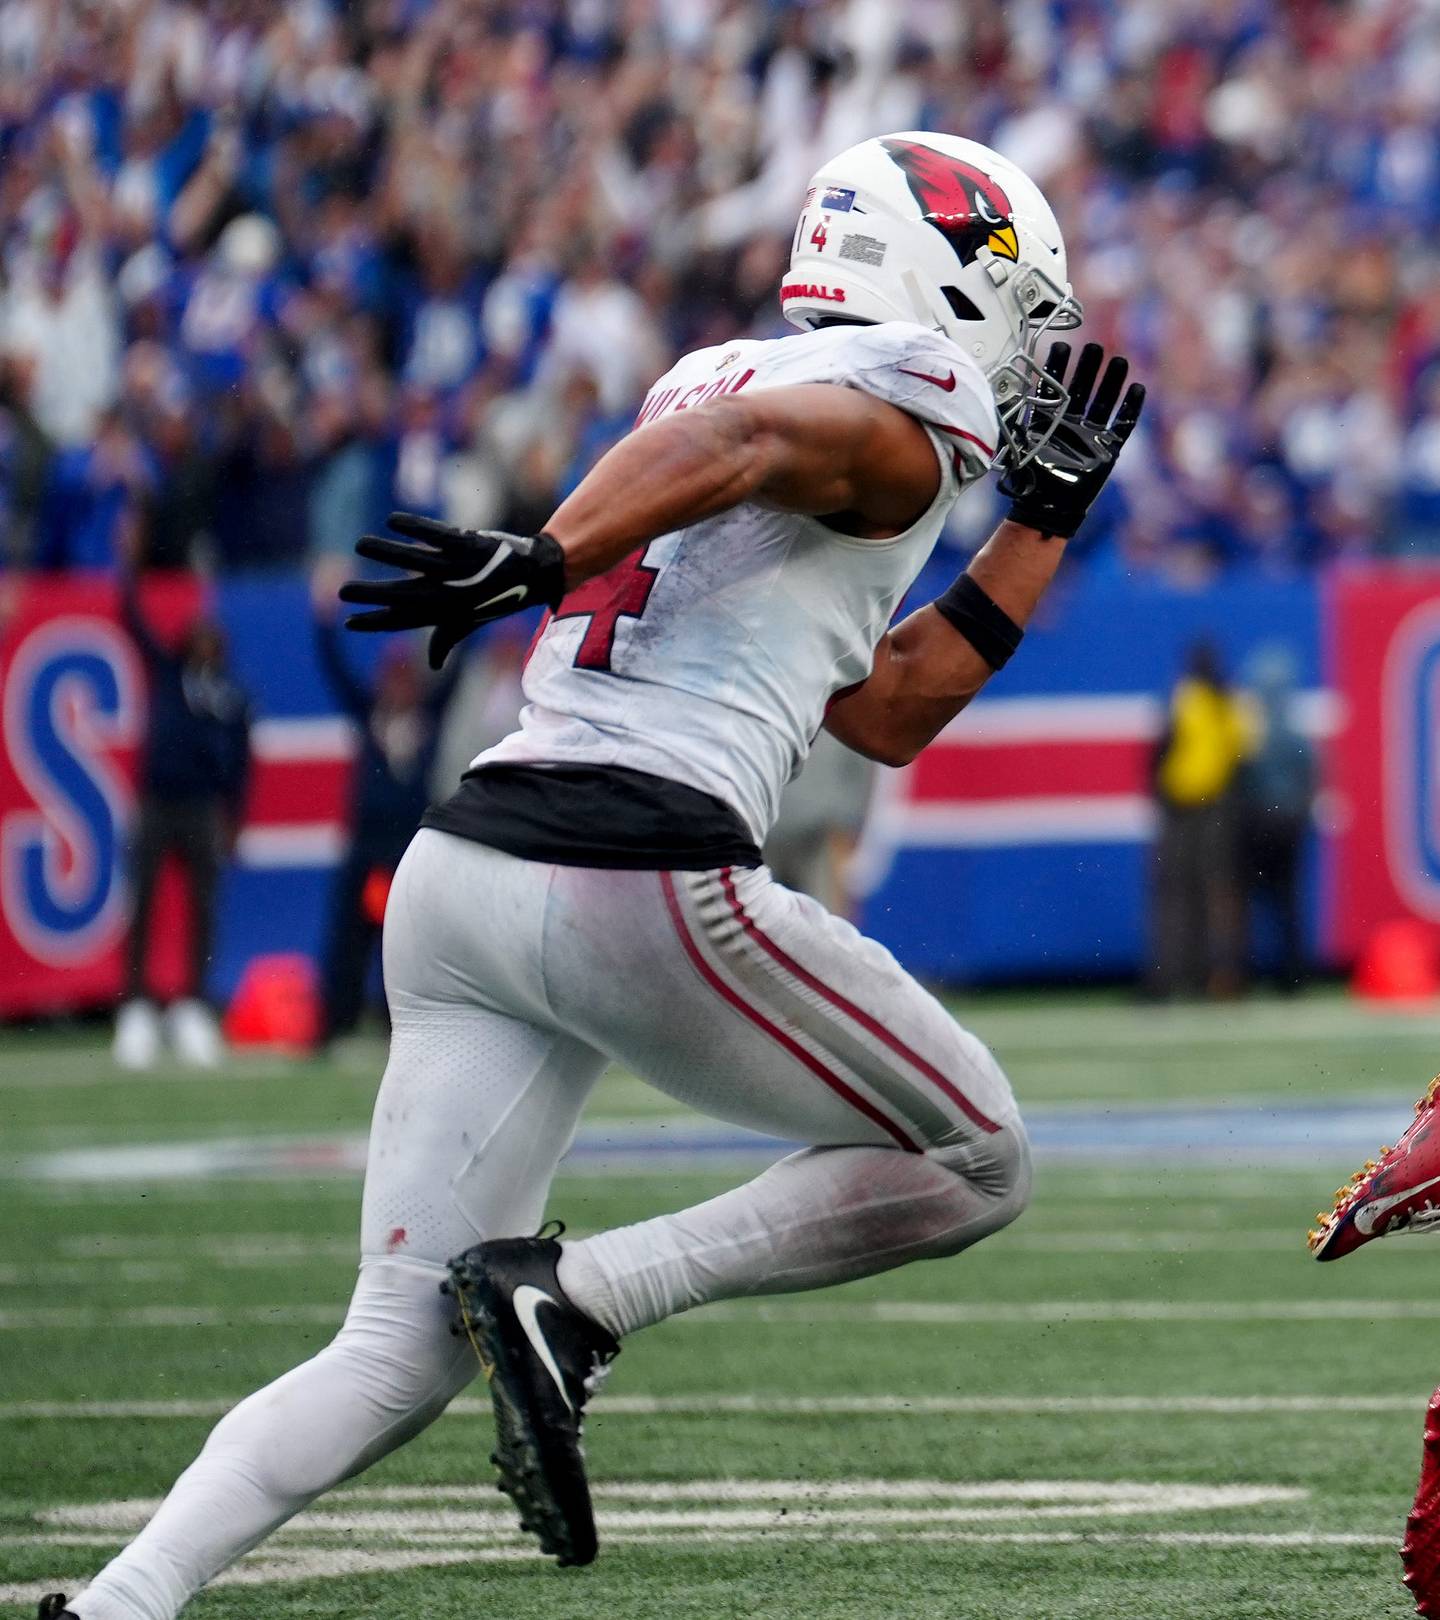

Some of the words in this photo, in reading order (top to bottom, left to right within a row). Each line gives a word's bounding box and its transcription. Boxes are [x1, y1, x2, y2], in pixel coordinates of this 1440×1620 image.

[810, 214, 831, 252] 4
[521, 545, 660, 672] 4
[4, 615, 150, 970] S
